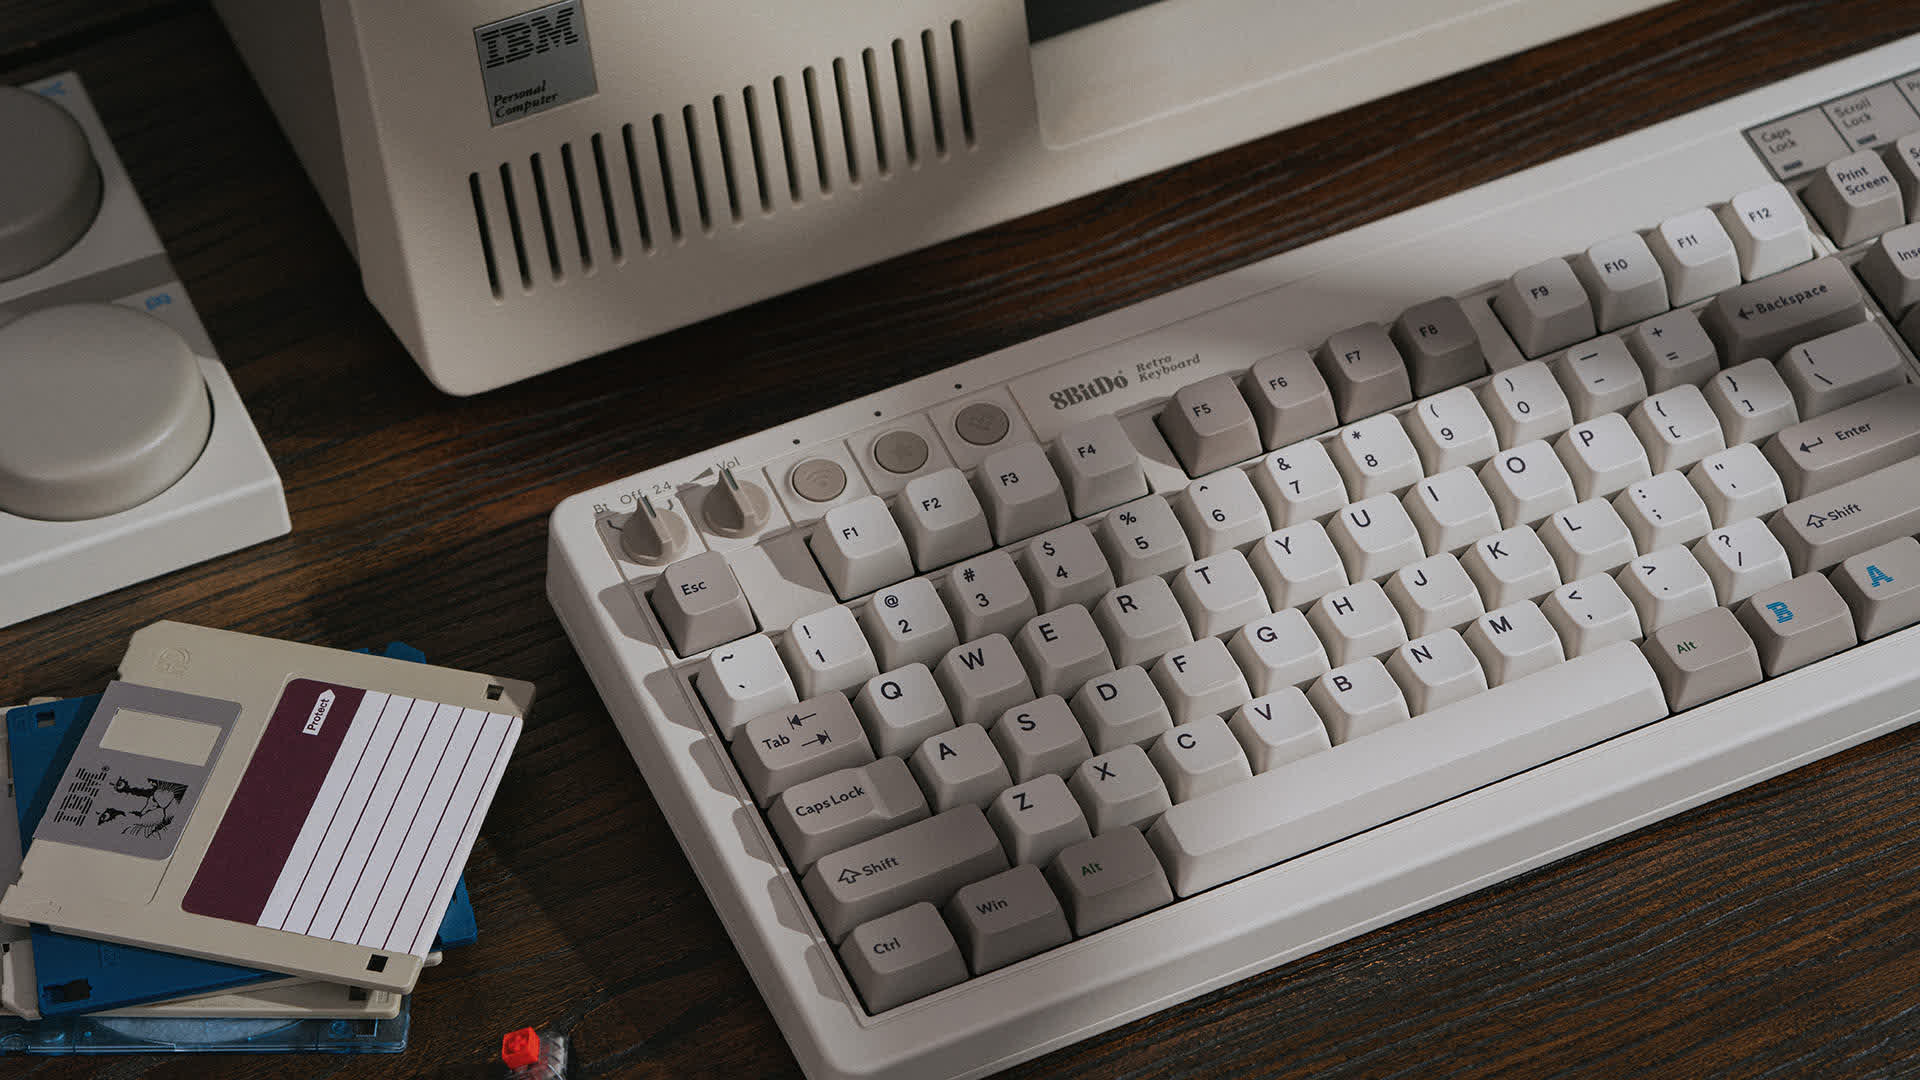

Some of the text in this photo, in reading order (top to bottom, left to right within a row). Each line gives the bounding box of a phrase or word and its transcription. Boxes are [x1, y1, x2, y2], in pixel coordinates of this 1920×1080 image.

[480, 7, 579, 69] IBM
[494, 80, 546, 107] Personal
[495, 93, 558, 118] Computer
[1834, 98, 1872, 117] Scroll
[1837, 166, 1869, 184] Print
[1845, 175, 1889, 196] Screen
[1748, 207, 1772, 223] F12
[1677, 235, 1697, 248] F11
[1604, 259, 1627, 273] F10
[1530, 284, 1550, 299] F9
[1755, 283, 1829, 315] Backspace
[1419, 325, 1438, 337] F8
[1652, 328, 1662, 336] +
[1136, 355, 1172, 372] Retro
[1344, 350, 1362, 363] F7
[1666, 352, 1679, 360] =
[1138, 353, 1200, 382] Keyboard
[1270, 377, 1287, 390] F6
[1505, 378, 1513, 392] )
[1727, 376, 1738, 392] }
[1193, 404, 1211, 417] F5
[1430, 404, 1439, 417] (
[1656, 401, 1666, 416] {
[1742, 400, 1754, 412] ]
[1441, 428, 1453, 440] 9
[1579, 431, 1593, 446] P
[1669, 426, 1680, 438] [
[1834, 422, 1872, 441] Enter
[1078, 445, 1096, 458] F4
[716, 456, 741, 471] Vol
[1277, 458, 1291, 470] &
[1365, 455, 1378, 467] 8
[1506, 457, 1525, 473] O
[1001, 473, 1019, 486] F3
[1289, 480, 1300, 494] 7
[593, 502, 611, 514] Bt
[620, 488, 643, 505] Off
[1428, 486, 1438, 501] I
[922, 498, 941, 511] F2
[1827, 503, 1863, 521] Shift
[1120, 512, 1136, 525] %
[1212, 509, 1225, 522] 6
[1351, 510, 1370, 527] U
[1563, 517, 1581, 531] L
[843, 527, 858, 539] F1
[1043, 541, 1055, 556] $
[1135, 536, 1149, 549] 5
[1275, 537, 1291, 554] Y
[1719, 535, 1731, 547] ?
[1487, 542, 1508, 559] K
[963, 568, 975, 582] #
[1057, 566, 1068, 578] 4
[1195, 566, 1211, 584] T
[1415, 570, 1427, 586] J
[1643, 566, 1656, 575] >
[1866, 565, 1893, 587] A
[681, 582, 706, 595] Esc
[1569, 591, 1582, 599] <
[884, 595, 898, 608] @
[976, 593, 989, 607] 3
[1117, 595, 1138, 613] R
[1332, 597, 1354, 615] H
[1766, 602, 1793, 623] B
[803, 625, 811, 638] !
[898, 619, 912, 633] 2
[1039, 623, 1058, 642] E
[1489, 616, 1512, 634] M
[1257, 627, 1277, 642] G
[1411, 645, 1432, 663] N
[1676, 640, 1698, 655] Alt
[816, 649, 825, 662] 1
[959, 648, 984, 670] W
[1173, 655, 1186, 672] F
[881, 682, 903, 699] Q
[1333, 676, 1352, 692] B
[1096, 684, 1117, 701] D
[307, 697, 329, 732] Protect
[1254, 704, 1271, 720] V
[1017, 714, 1036, 731] S
[762, 735, 790, 749] Tab
[1177, 734, 1196, 749] C
[939, 743, 957, 760] A
[1093, 762, 1116, 780] X
[795, 784, 865, 818] Caps Lock
[1013, 792, 1033, 811] Z
[862, 858, 898, 876] Shift
[1081, 863, 1103, 877] Alt
[975, 899, 1009, 915] Win
[873, 937, 902, 956] Ctrl
